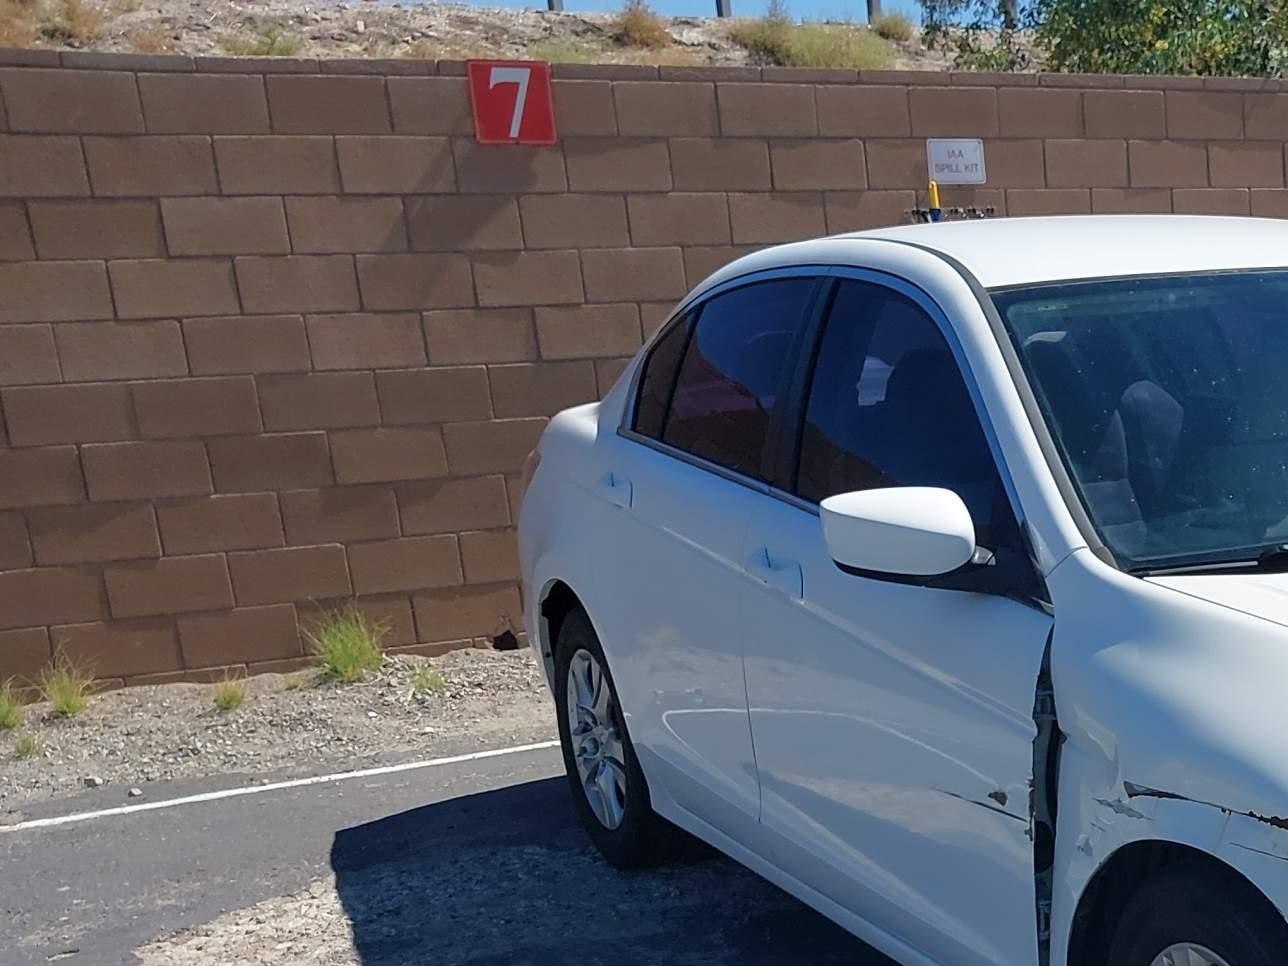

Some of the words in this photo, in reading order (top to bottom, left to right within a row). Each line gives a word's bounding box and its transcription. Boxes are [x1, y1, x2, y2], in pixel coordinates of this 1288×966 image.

[489, 67, 531, 138] 7
[946, 149, 965, 160] IAA
[934, 163, 962, 174] SPILL
[963, 163, 979, 173] KIT
